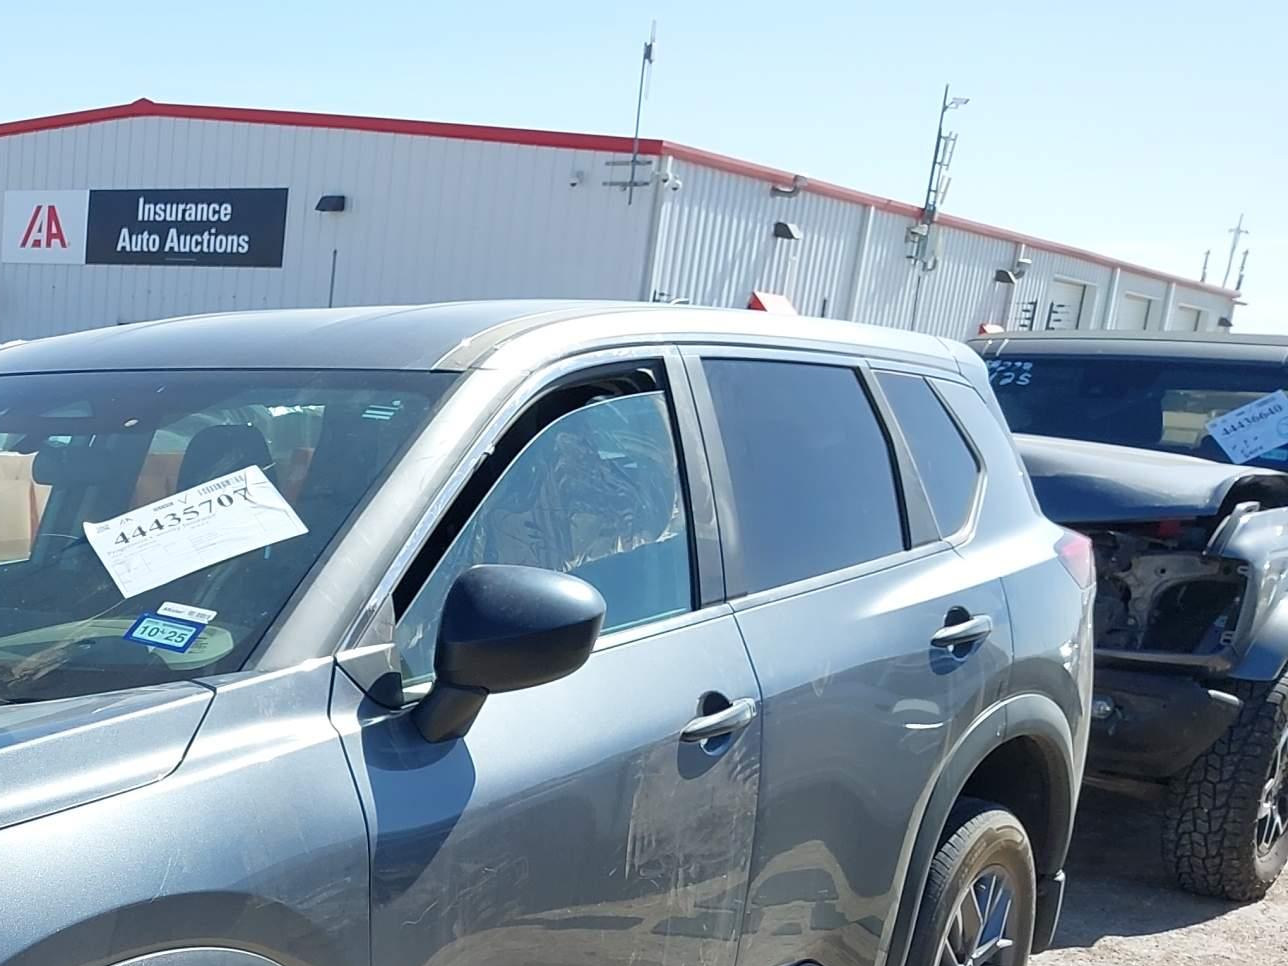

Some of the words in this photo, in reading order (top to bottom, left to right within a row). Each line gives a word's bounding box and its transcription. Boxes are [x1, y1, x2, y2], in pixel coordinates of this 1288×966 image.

[138, 197, 232, 221] Insurance
[116, 228, 160, 252] Auto
[164, 228, 249, 253] Auctions
[114, 487, 250, 546] 44435707
[139, 625, 161, 638] 10
[164, 631, 189, 644] 25
